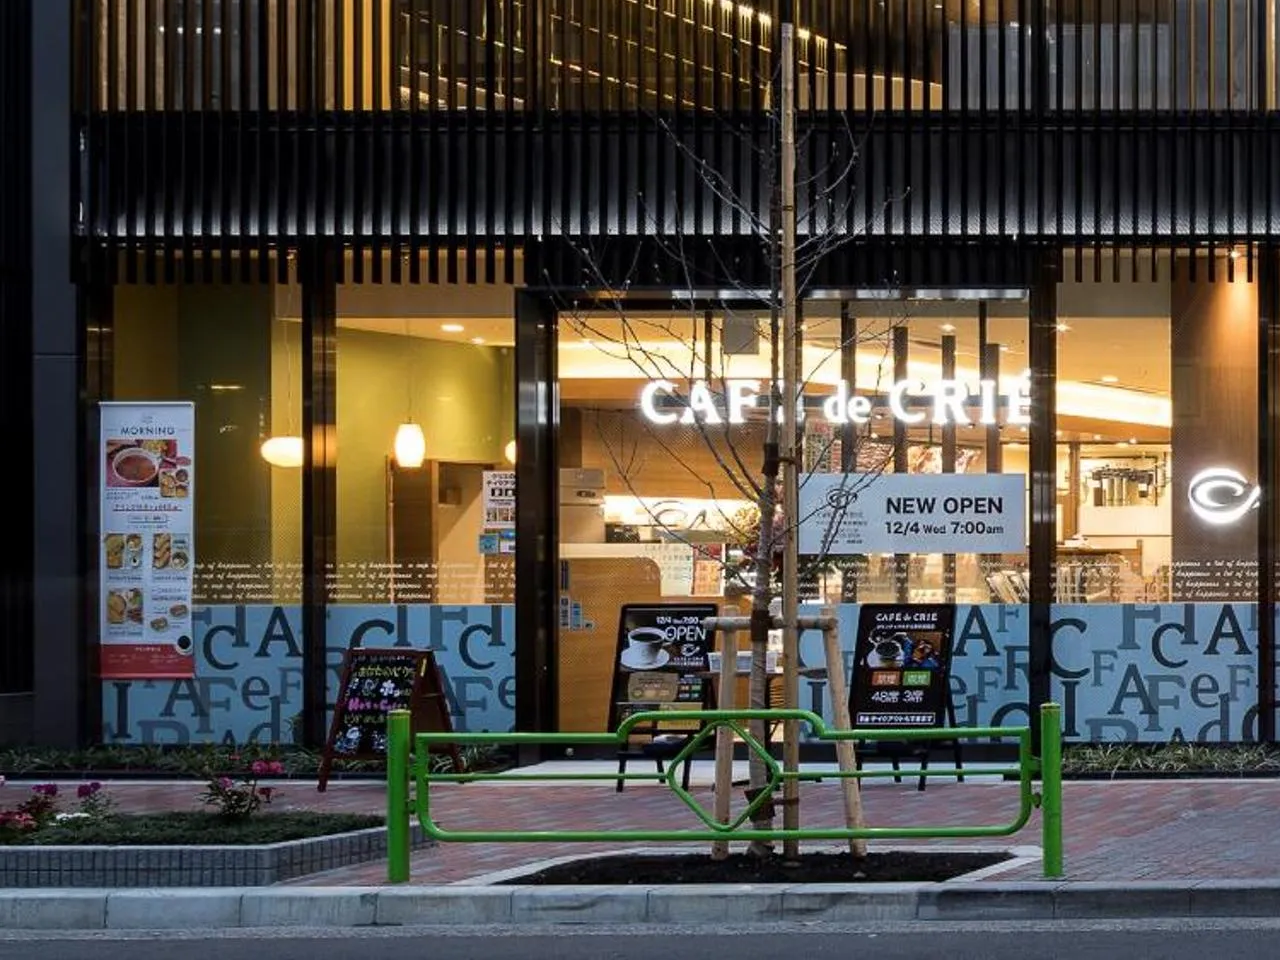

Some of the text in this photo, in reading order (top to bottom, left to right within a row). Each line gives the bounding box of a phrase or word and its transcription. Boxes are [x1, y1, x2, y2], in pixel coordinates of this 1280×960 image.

[640, 378, 806, 424] CAF
[824, 381, 869, 423] de
[121, 426, 176, 436] MORNING
[886, 497, 1004, 514] NEW OPEN
[886, 521, 920, 534] 12/4
[923, 523, 946, 534] Wed
[664, 626, 706, 642] OPEN
